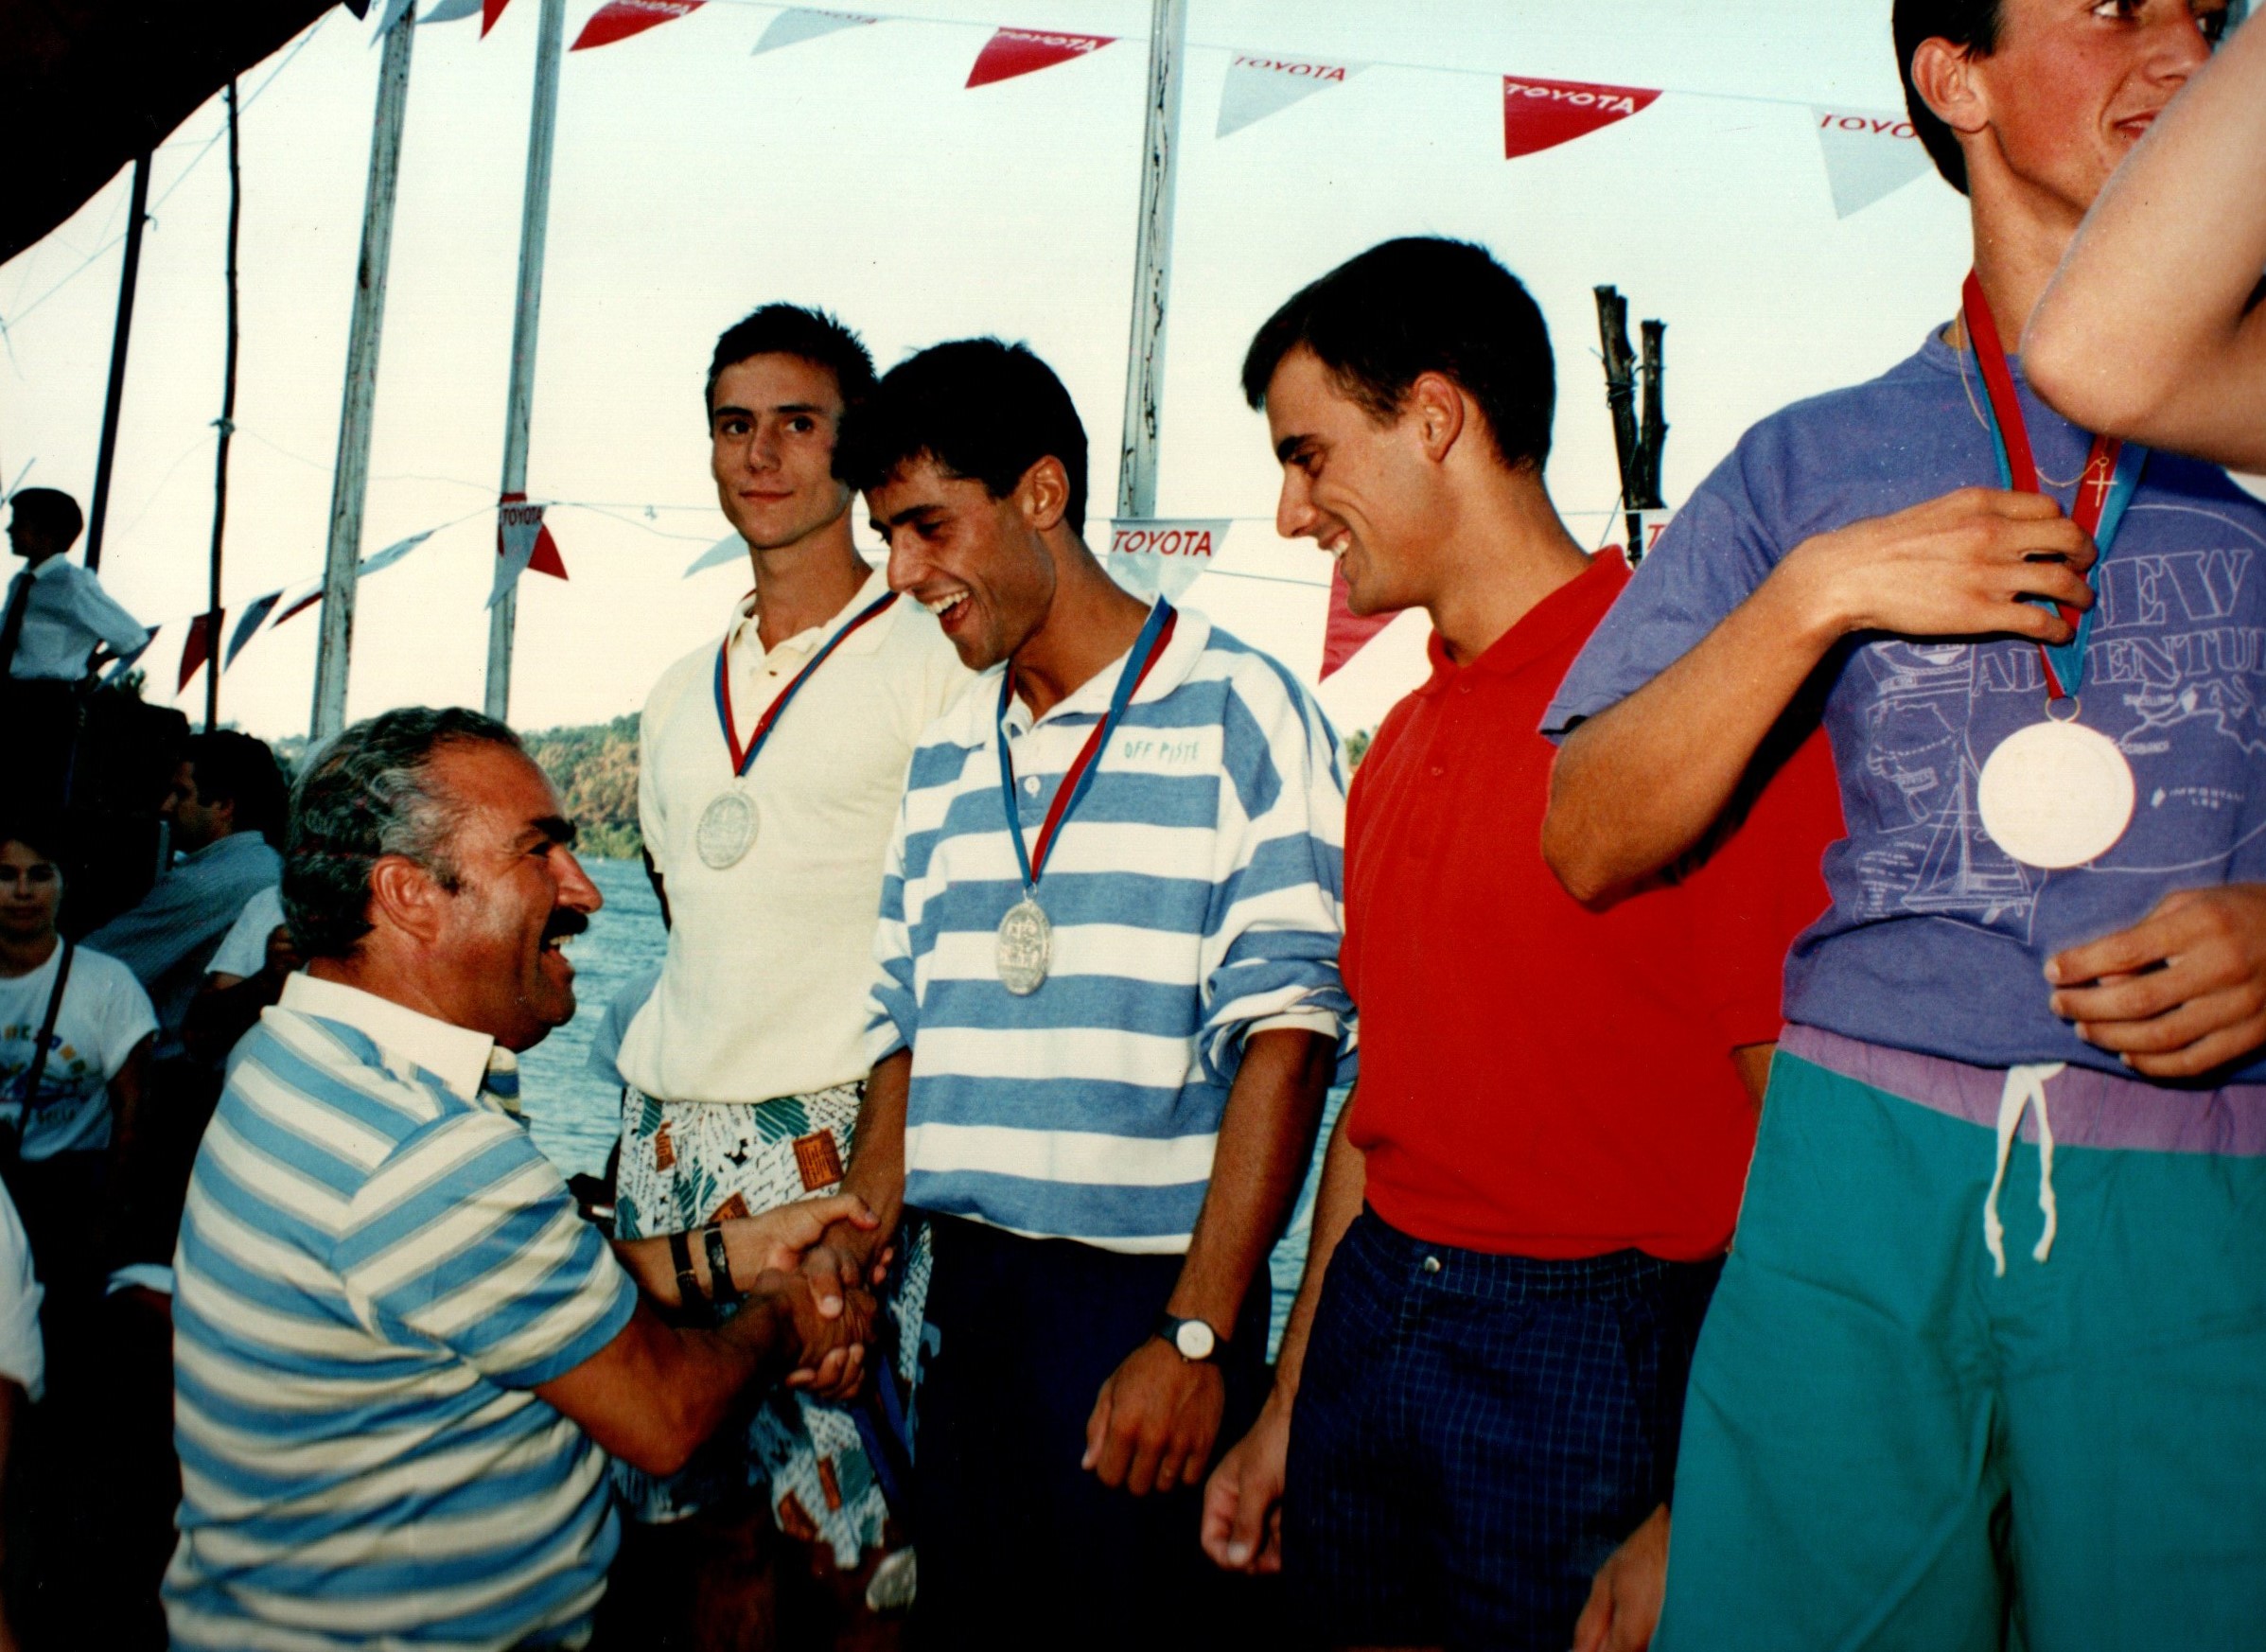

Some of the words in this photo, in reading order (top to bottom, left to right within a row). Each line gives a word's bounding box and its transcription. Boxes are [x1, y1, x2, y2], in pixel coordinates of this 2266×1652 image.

[1234, 57, 1345, 81] TOYOTA
[1506, 83, 1634, 114] TOYOTA
[1112, 530, 1212, 557] TOYOTA
[2092, 548, 2253, 631] EW
[1124, 740, 1153, 759] OFF
